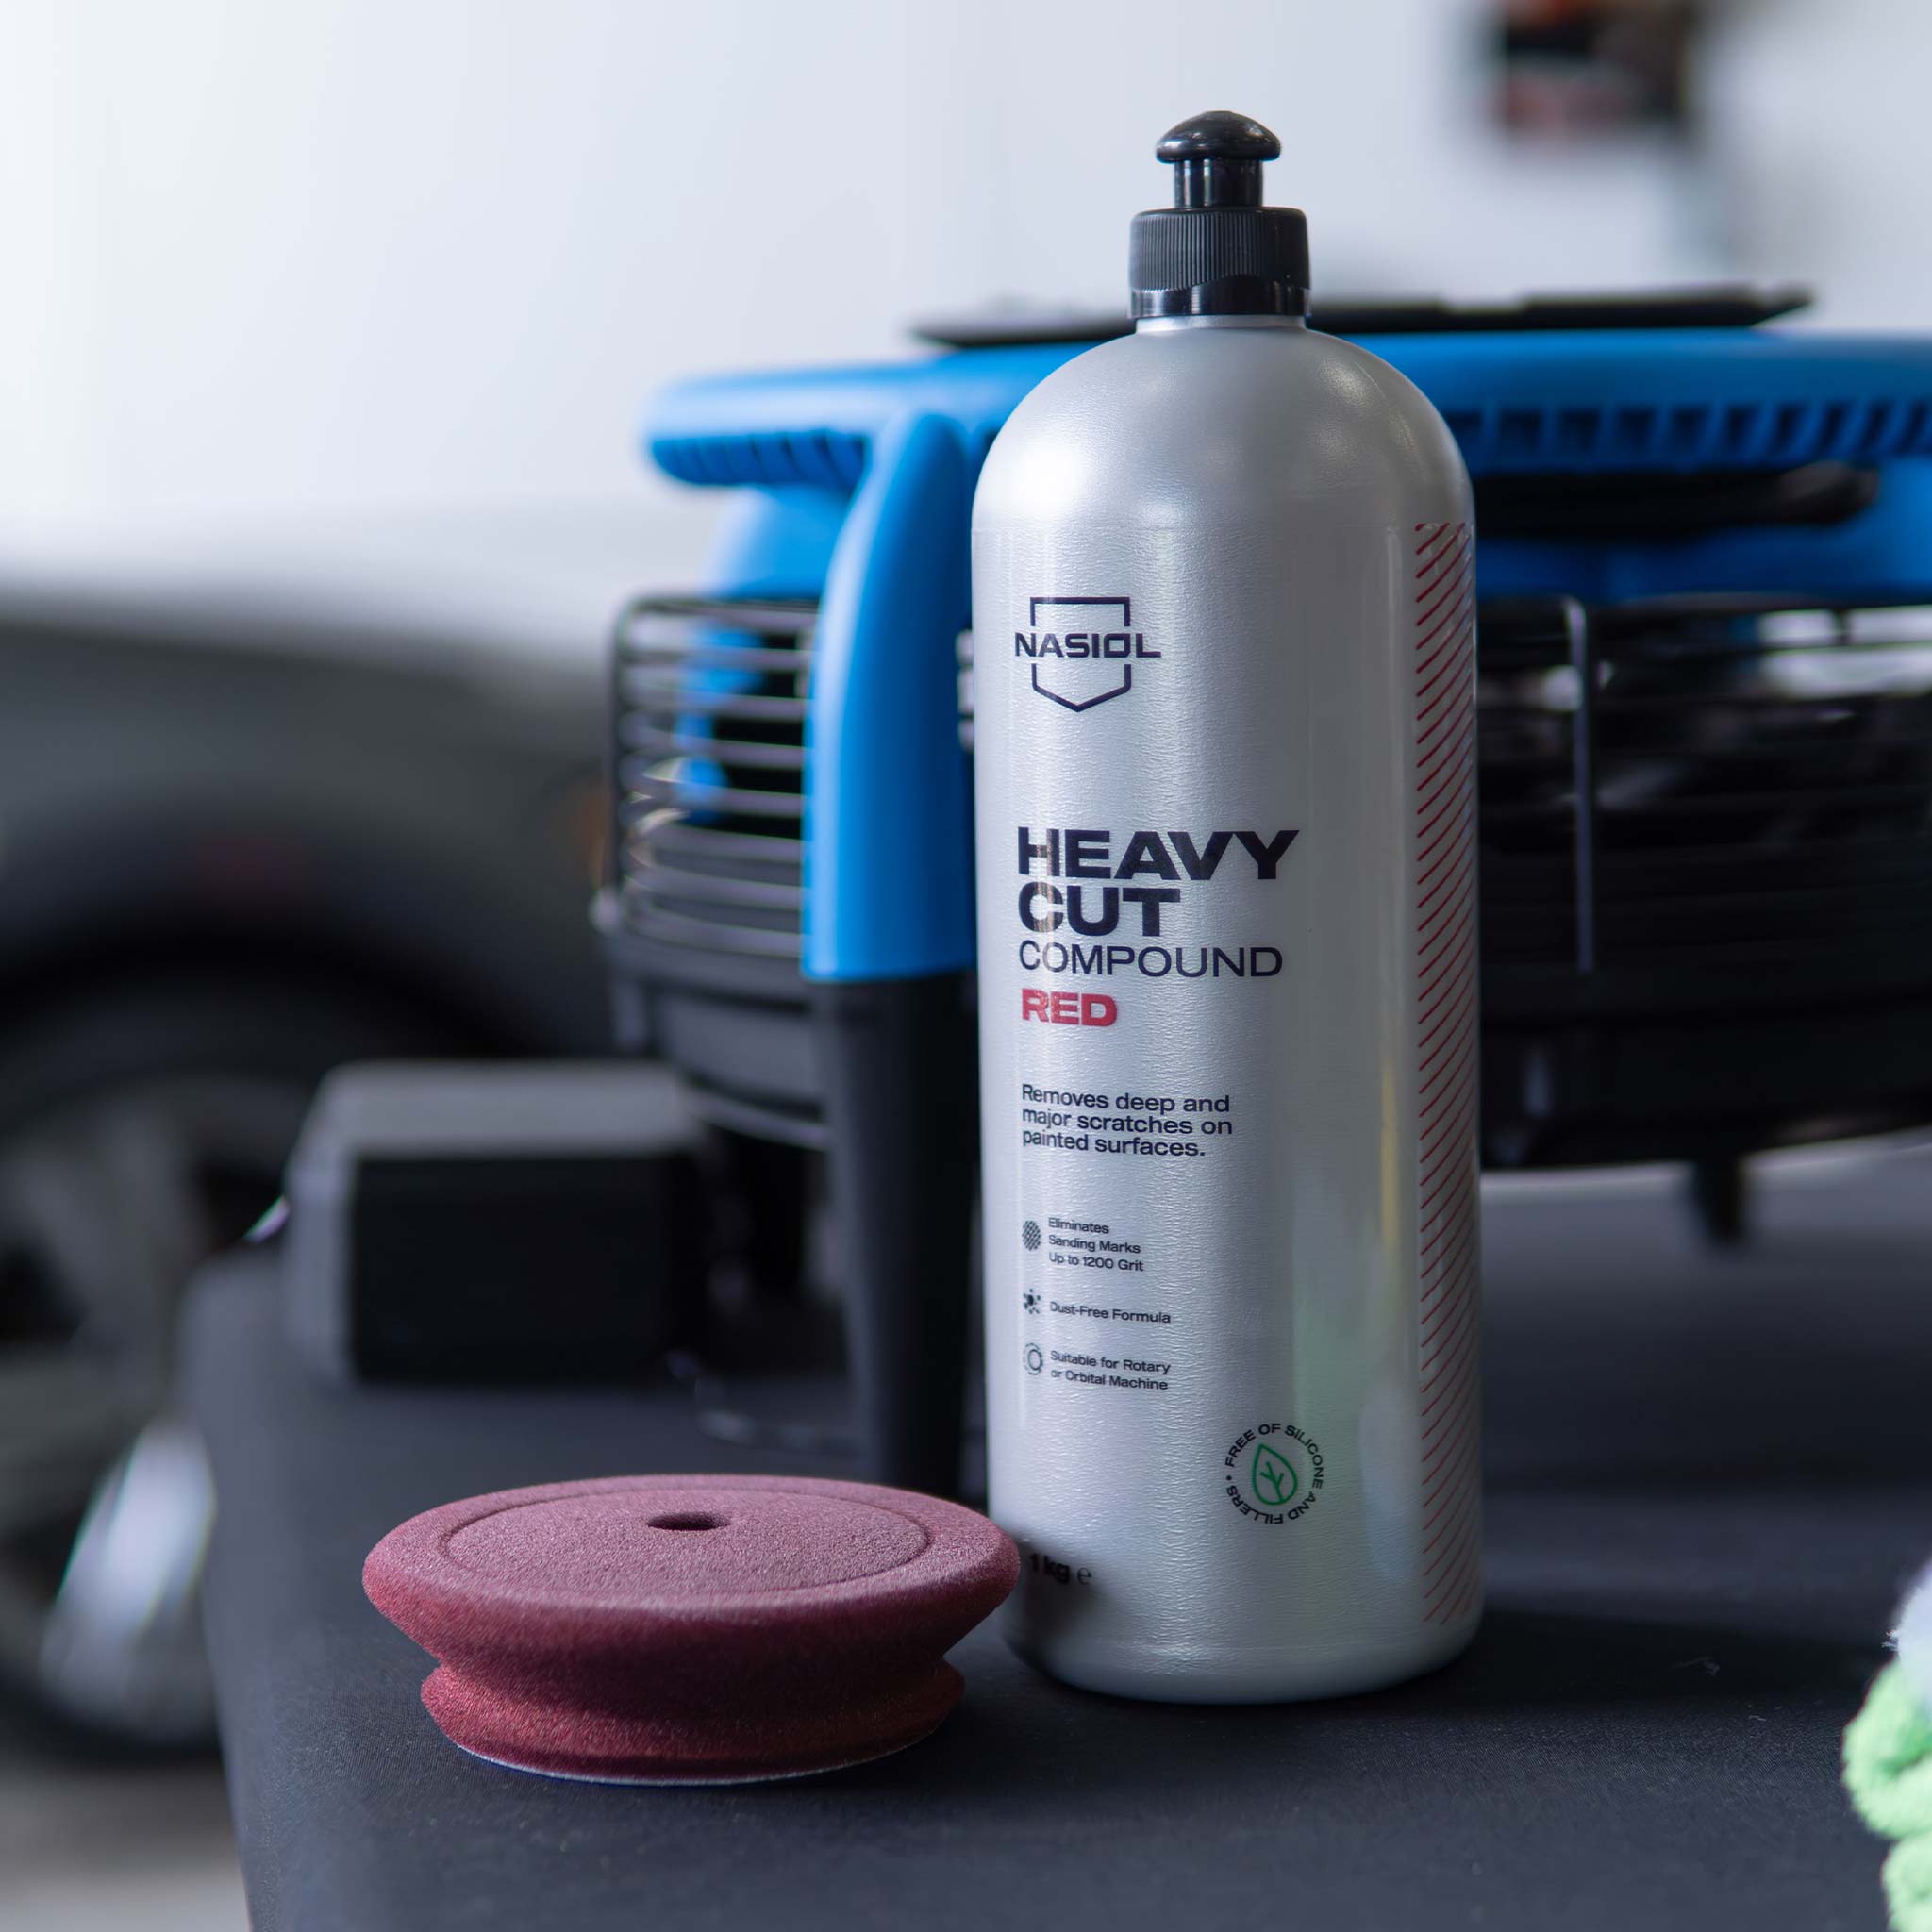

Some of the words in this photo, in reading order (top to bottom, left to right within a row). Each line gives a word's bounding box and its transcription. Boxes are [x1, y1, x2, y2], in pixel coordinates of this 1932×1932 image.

[1014, 632, 1161, 658] NASIOL
[1018, 826, 1300, 881] HEAVY
[1018, 881, 1181, 937] CUT
[1019, 940, 1283, 978] COMPOUND
[1022, 988, 1118, 1027] RED
[1022, 1083, 1108, 1108] Removes
[1115, 1092, 1175, 1115] deep
[1183, 1095, 1230, 1113] and
[1022, 1108, 1072, 1129] major
[1076, 1114, 1193, 1134] scratches
[1201, 1120, 1233, 1135] on
[1023, 1130, 1089, 1151] painted
[1094, 1136, 1206, 1157] surfaces.
[1048, 1217, 1109, 1234] Eliminates
[1048, 1235, 1095, 1253] Sanding
[1099, 1241, 1141, 1254] Marks
[1049, 1252, 1065, 1265] Up
[1068, 1254, 1079, 1265] to
[1083, 1257, 1114, 1269] 1200
[1118, 1259, 1144, 1272] Grit
[1050, 1301, 1108, 1319] Dust-Free
[1112, 1309, 1172, 1324] Formula
[1050, 1350, 1097, 1367] Suitable
[1101, 1357, 1120, 1368] for
[1124, 1360, 1171, 1375] Rotary
[1051, 1369, 1062, 1378] or
[1065, 1370, 1106, 1385] Orbital
[1109, 1375, 1169, 1391] Machine
[1258, 1423, 1281, 1435] OF
[1224, 1429, 1257, 1468] FREE
[1284, 1424, 1324, 1490] SILICONE
[1226, 1485, 1284, 1524] FILLERS
[1287, 1491, 1317, 1521] AND
[1029, 1553, 1040, 1574] 1
[1043, 1555, 1071, 1585] kg
